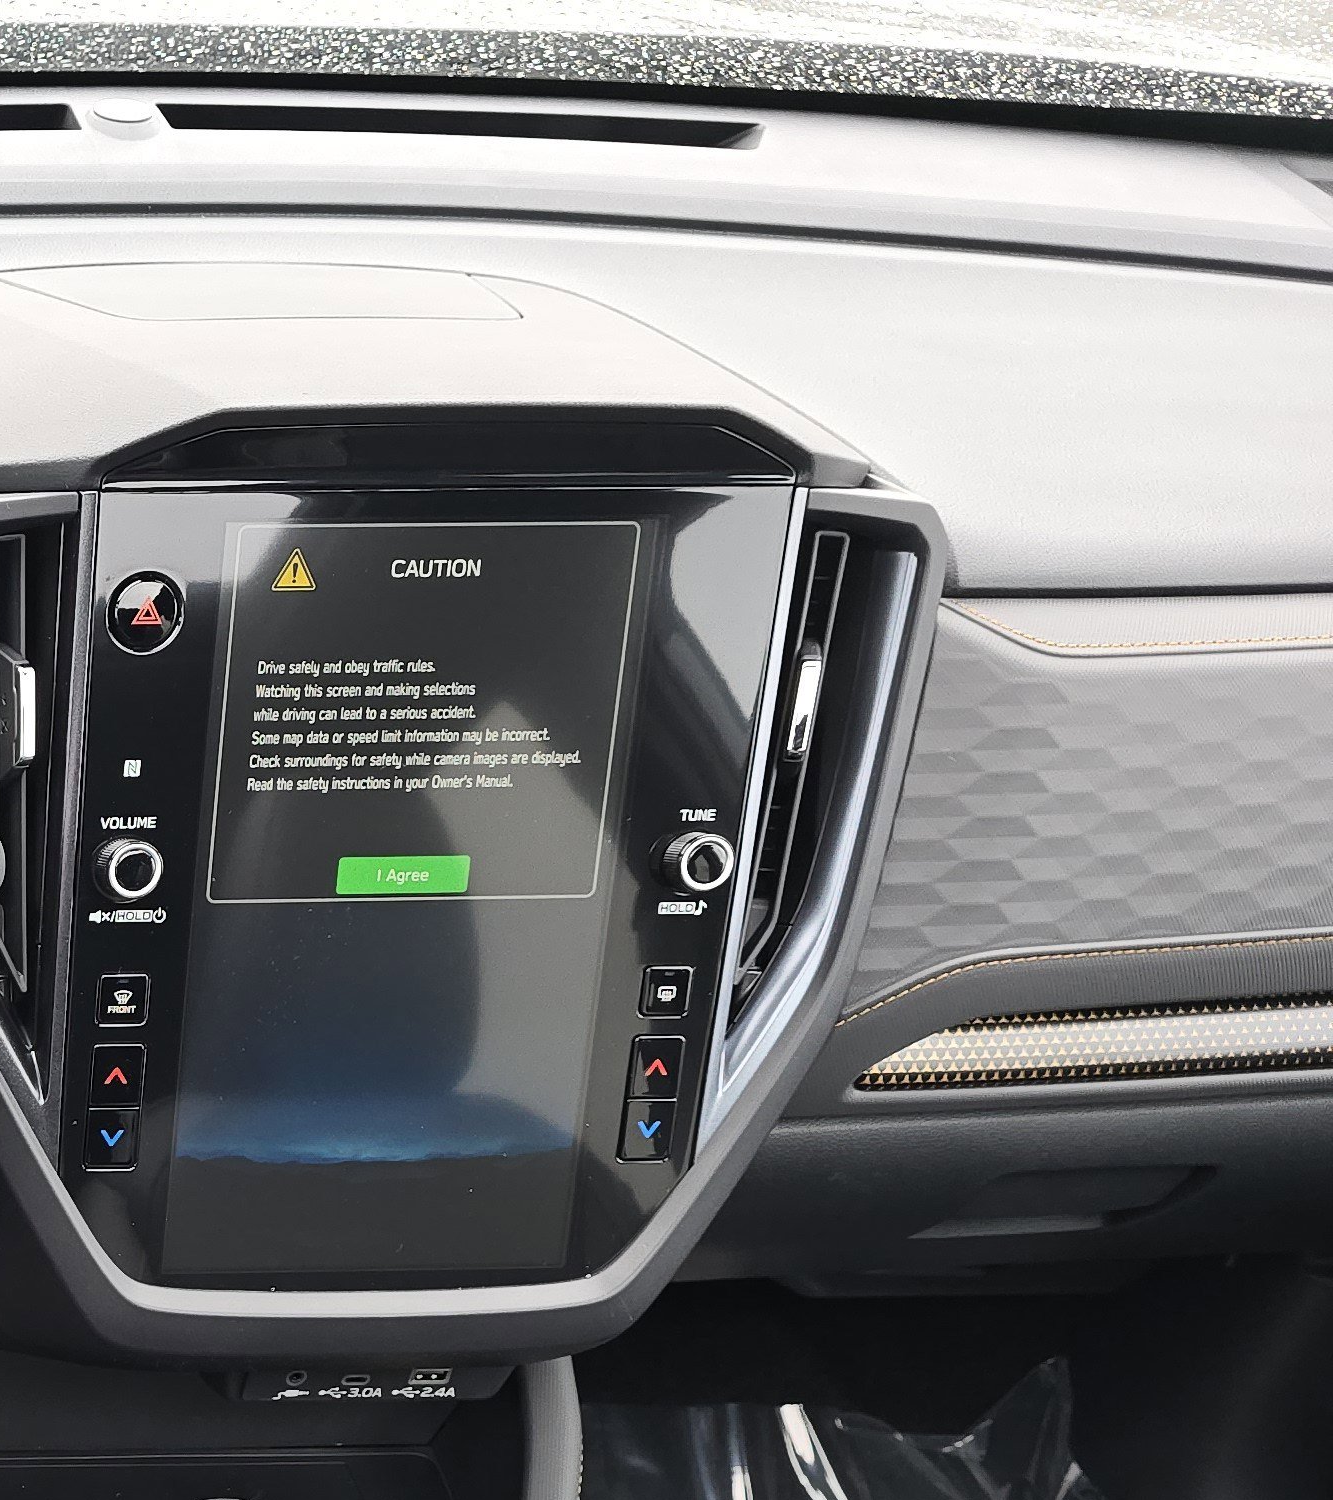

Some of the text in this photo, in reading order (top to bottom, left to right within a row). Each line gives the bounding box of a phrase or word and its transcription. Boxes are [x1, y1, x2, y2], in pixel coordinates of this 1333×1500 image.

[390, 558, 483, 579] CAUTION
[257, 659, 436, 677] Drive safely and obey traffic rules.
[255, 682, 476, 701] Watching this screen and making selections
[253, 705, 476, 724] while driving can lead to a serious accident.
[251, 727, 551, 747] Some map data or speed limit information may be incorrect.
[249, 750, 581, 770] Check surroundings for safety while camera images are displayed.
[247, 774, 513, 793] Read the safety instructions in your Owner's Manual.
[100, 816, 157, 829] VOLUME
[679, 808, 717, 822] TUNE
[376, 868, 430, 886] I Agree
[116, 910, 152, 922] HOLD
[659, 902, 694, 914] HOLD
[107, 1005, 136, 1014] FRONT
[347, 1386, 382, 1399] 3.0A
[419, 1386, 456, 1399] 2.4A
